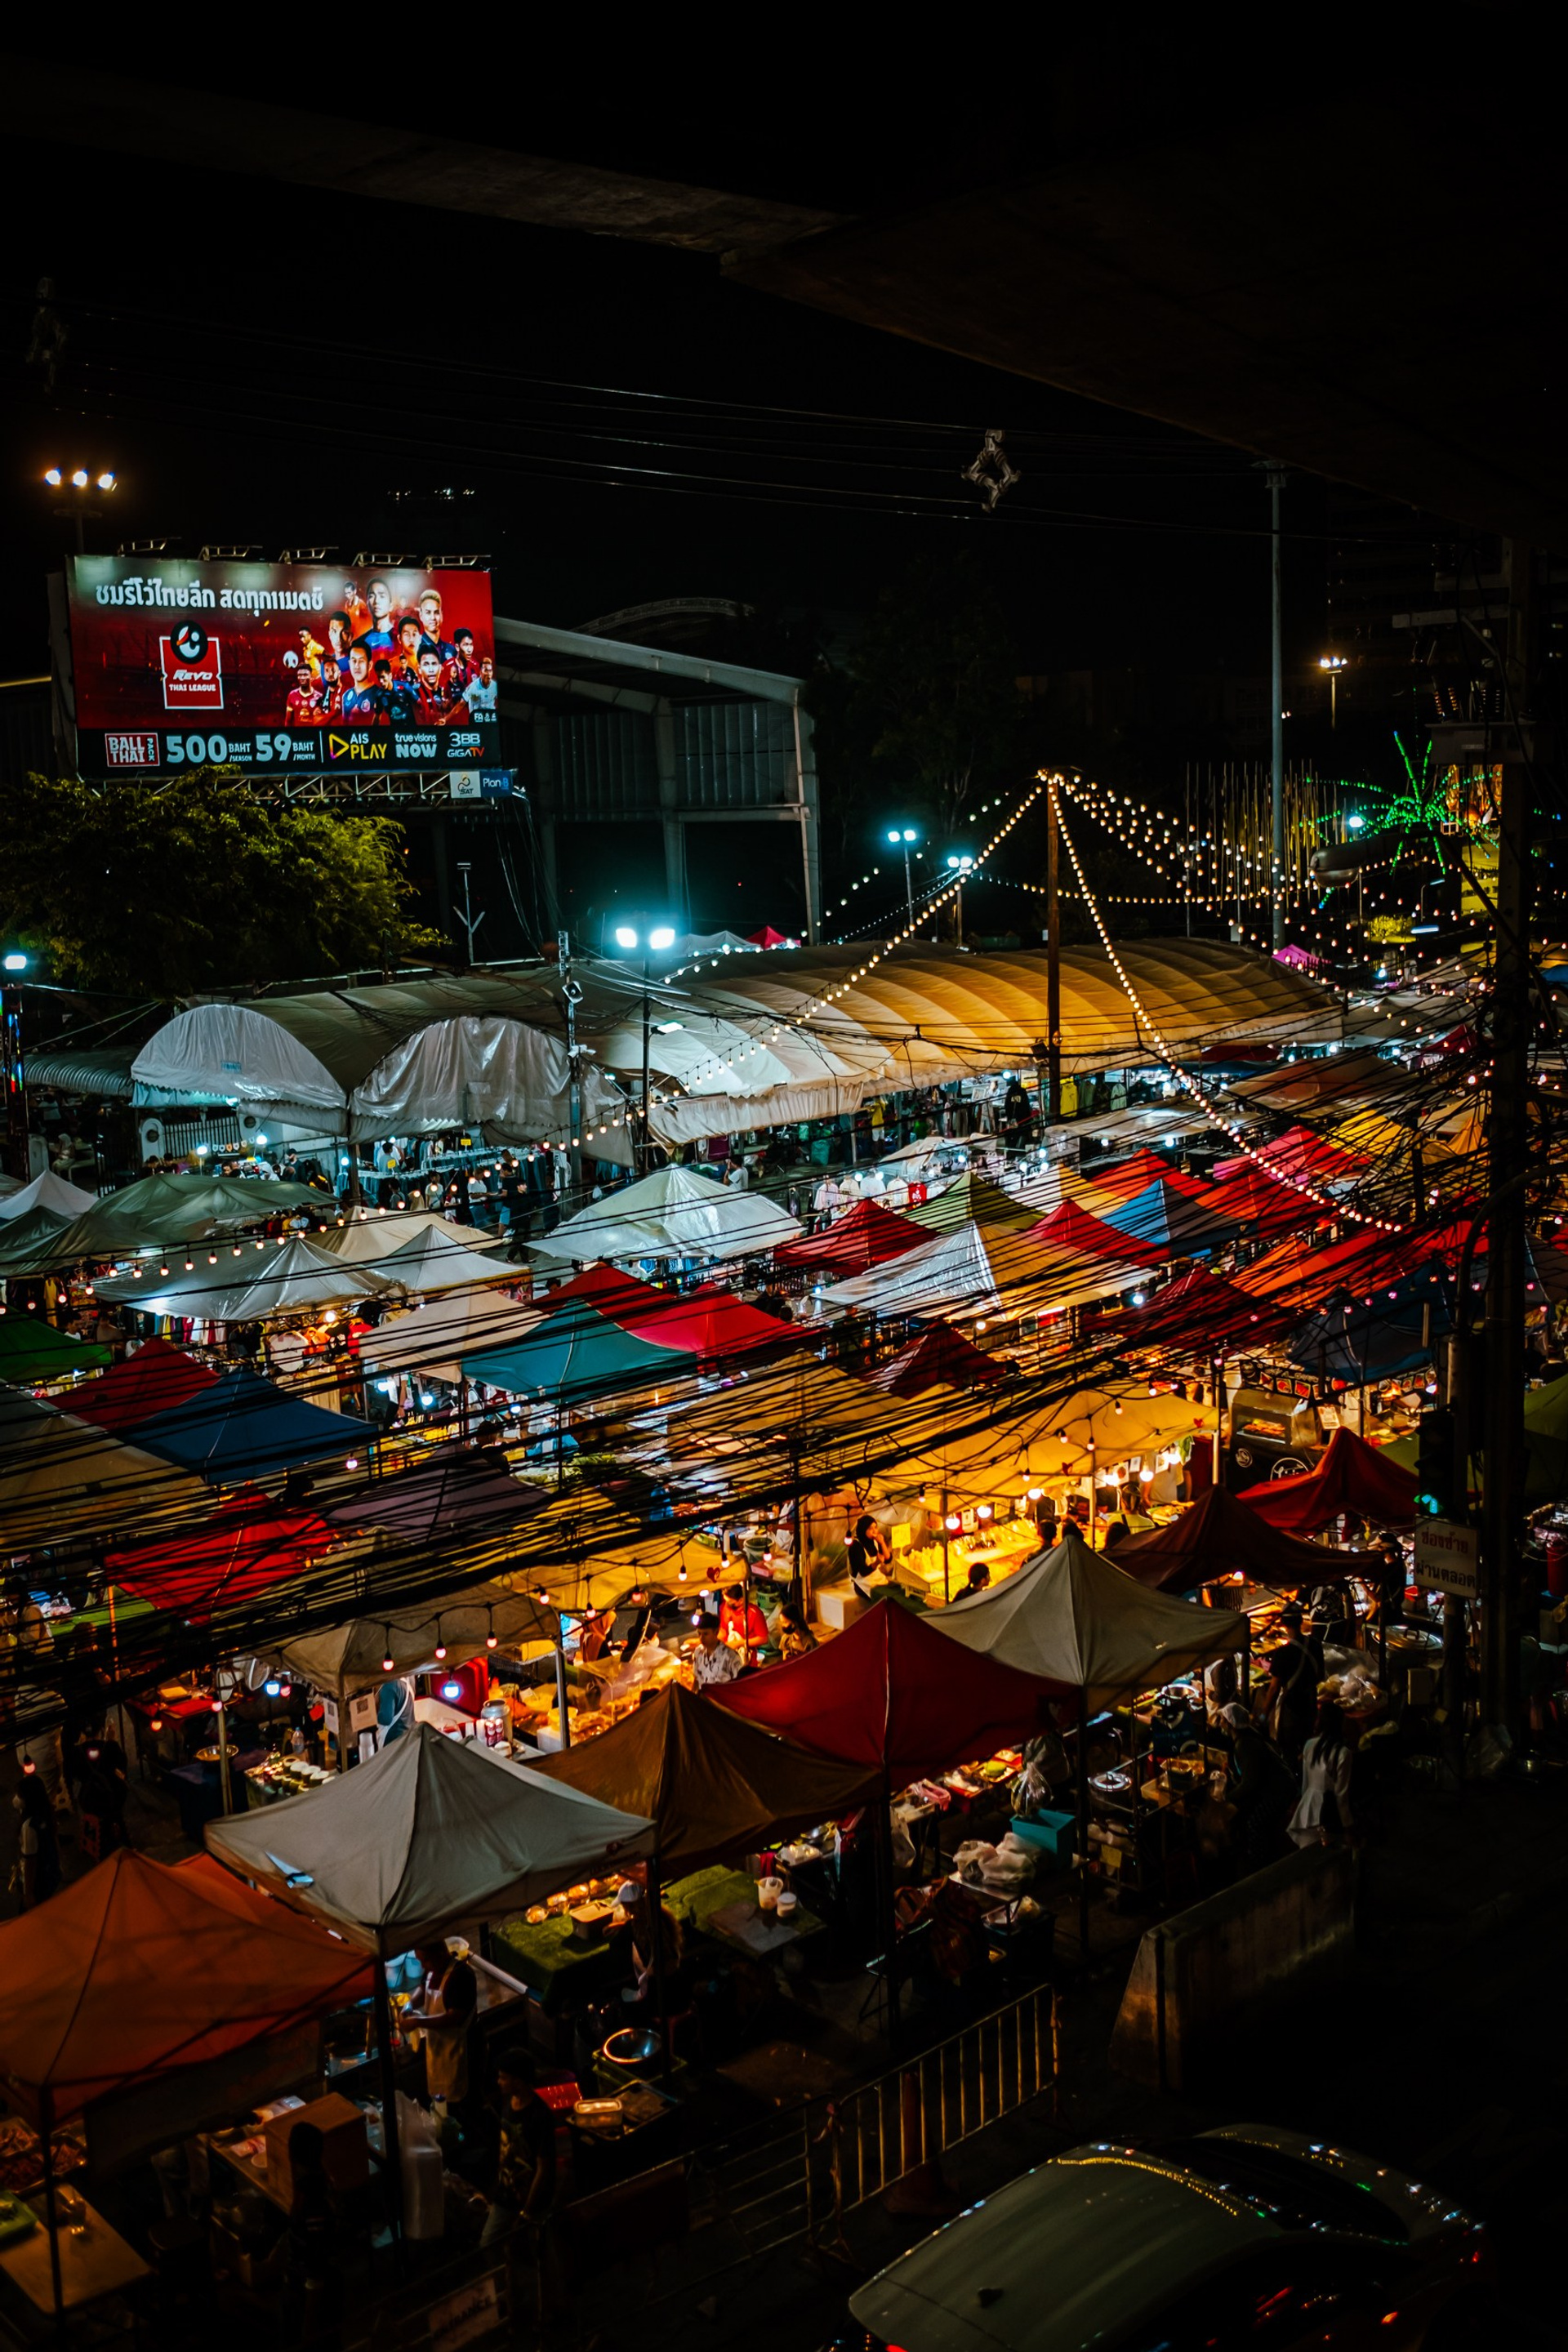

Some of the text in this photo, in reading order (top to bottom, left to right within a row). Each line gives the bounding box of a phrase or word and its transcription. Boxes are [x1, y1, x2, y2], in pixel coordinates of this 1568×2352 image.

[96, 577, 216, 608] ชมรีโว่ไทยลีก
[169, 684, 216, 692] THAI LEAGUE
[108, 737, 145, 751] BALL
[350, 733, 369, 744] AIS
[449, 733, 480, 746] 3BB
[147, 737, 155, 761] PACK
[166, 735, 252, 763] 500 BAHT
[256, 733, 314, 762] 59 BAHT
[350, 743, 388, 760] PLAY
[395, 744, 437, 758] NOW
[110, 751, 145, 763] THAI
